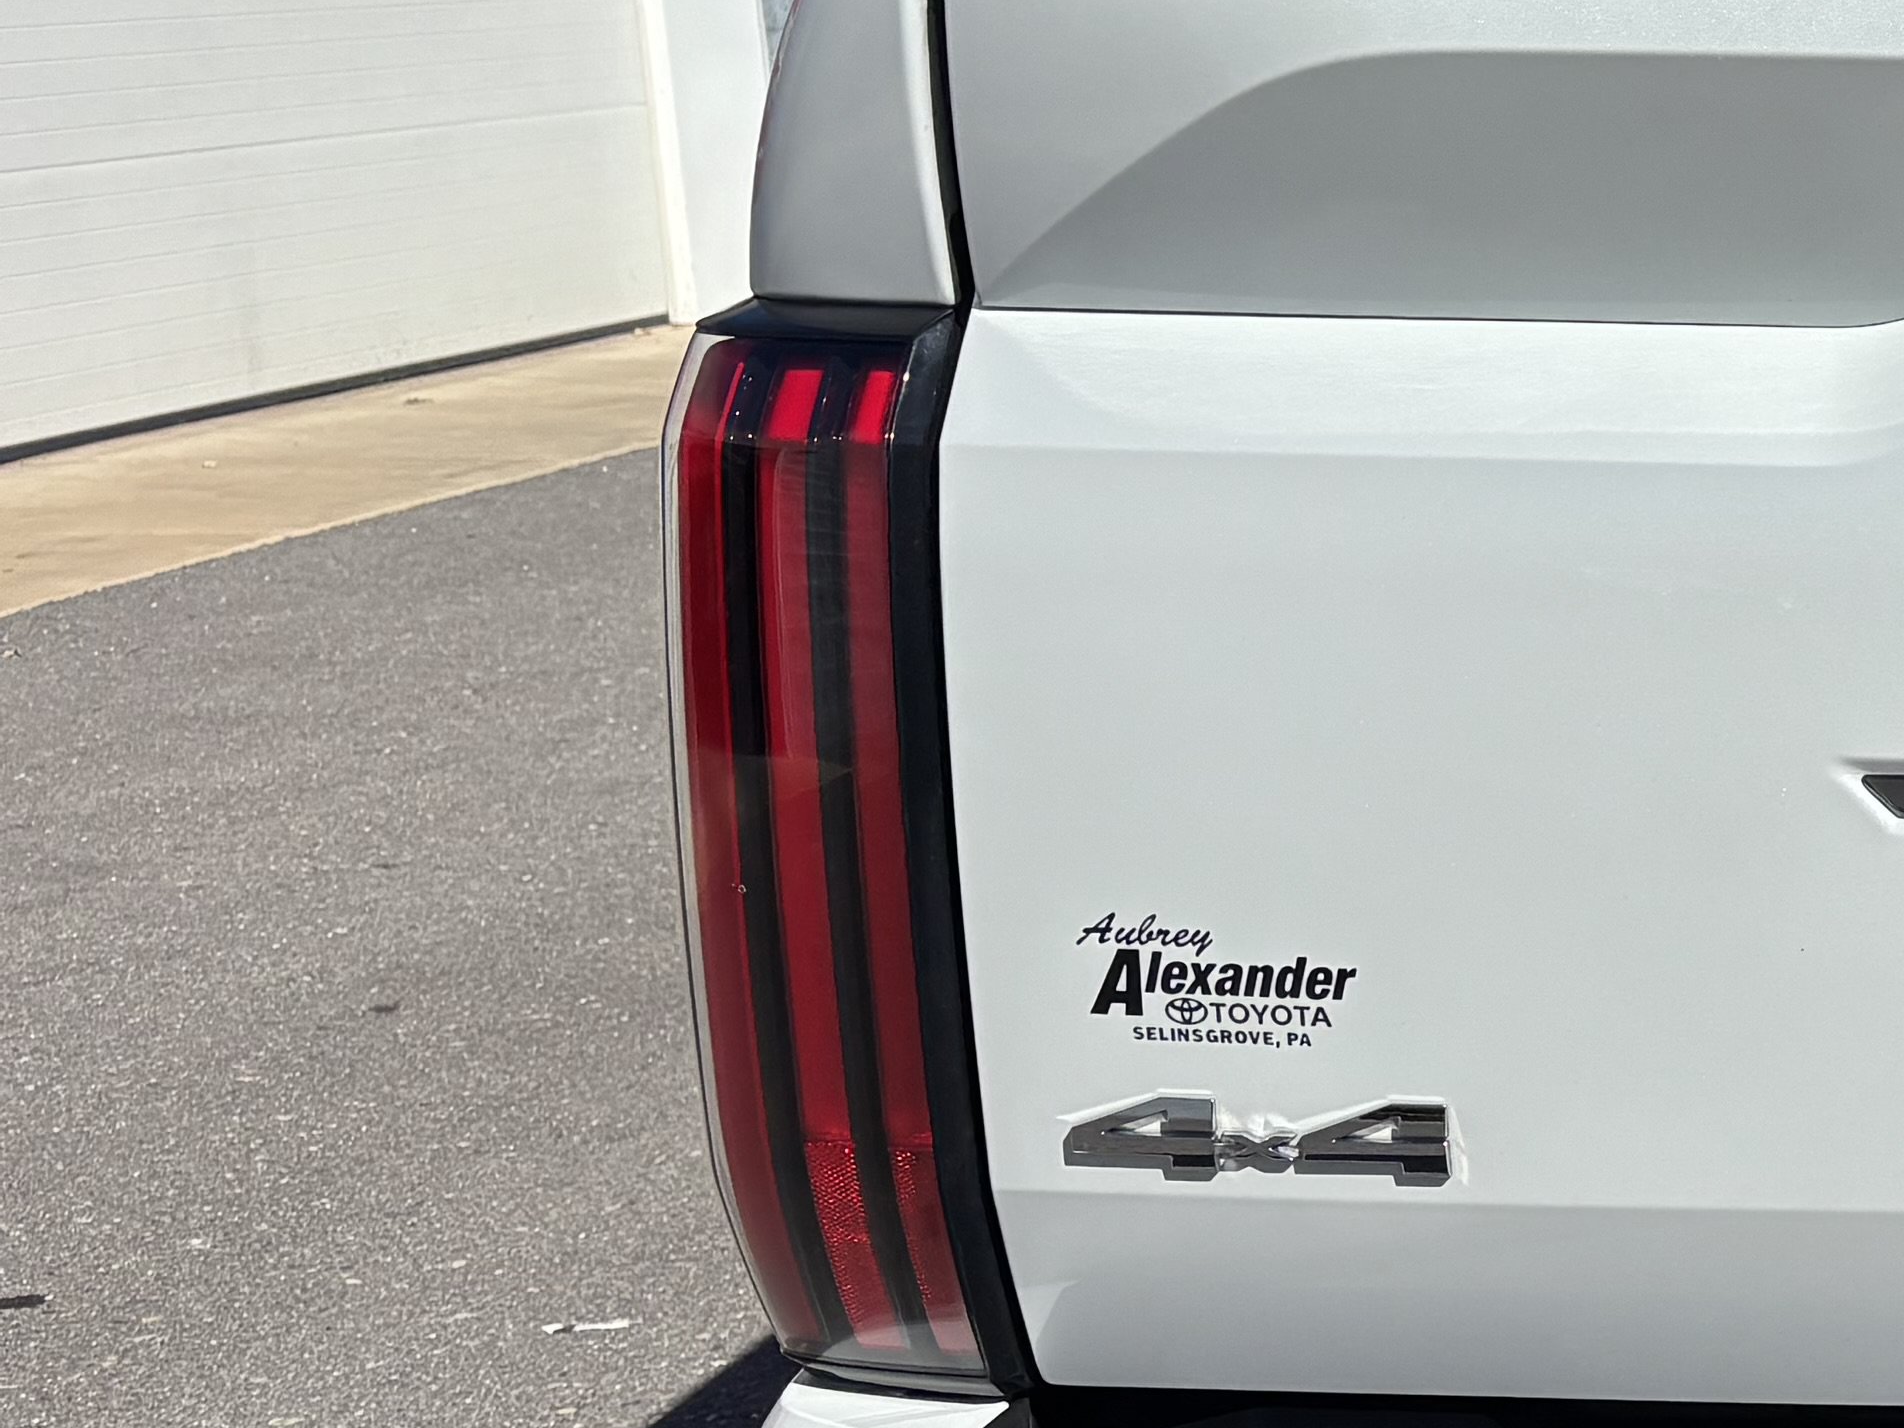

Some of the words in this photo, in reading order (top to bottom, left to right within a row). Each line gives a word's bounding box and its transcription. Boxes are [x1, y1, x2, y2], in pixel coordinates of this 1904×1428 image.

[1075, 911, 1214, 958] Aubrey
[1089, 947, 1358, 1017] Alexander
[1208, 1002, 1333, 1028] TOYOTA
[1132, 1025, 1281, 1049] SELINSGROVE,
[1286, 1032, 1313, 1047] PA
